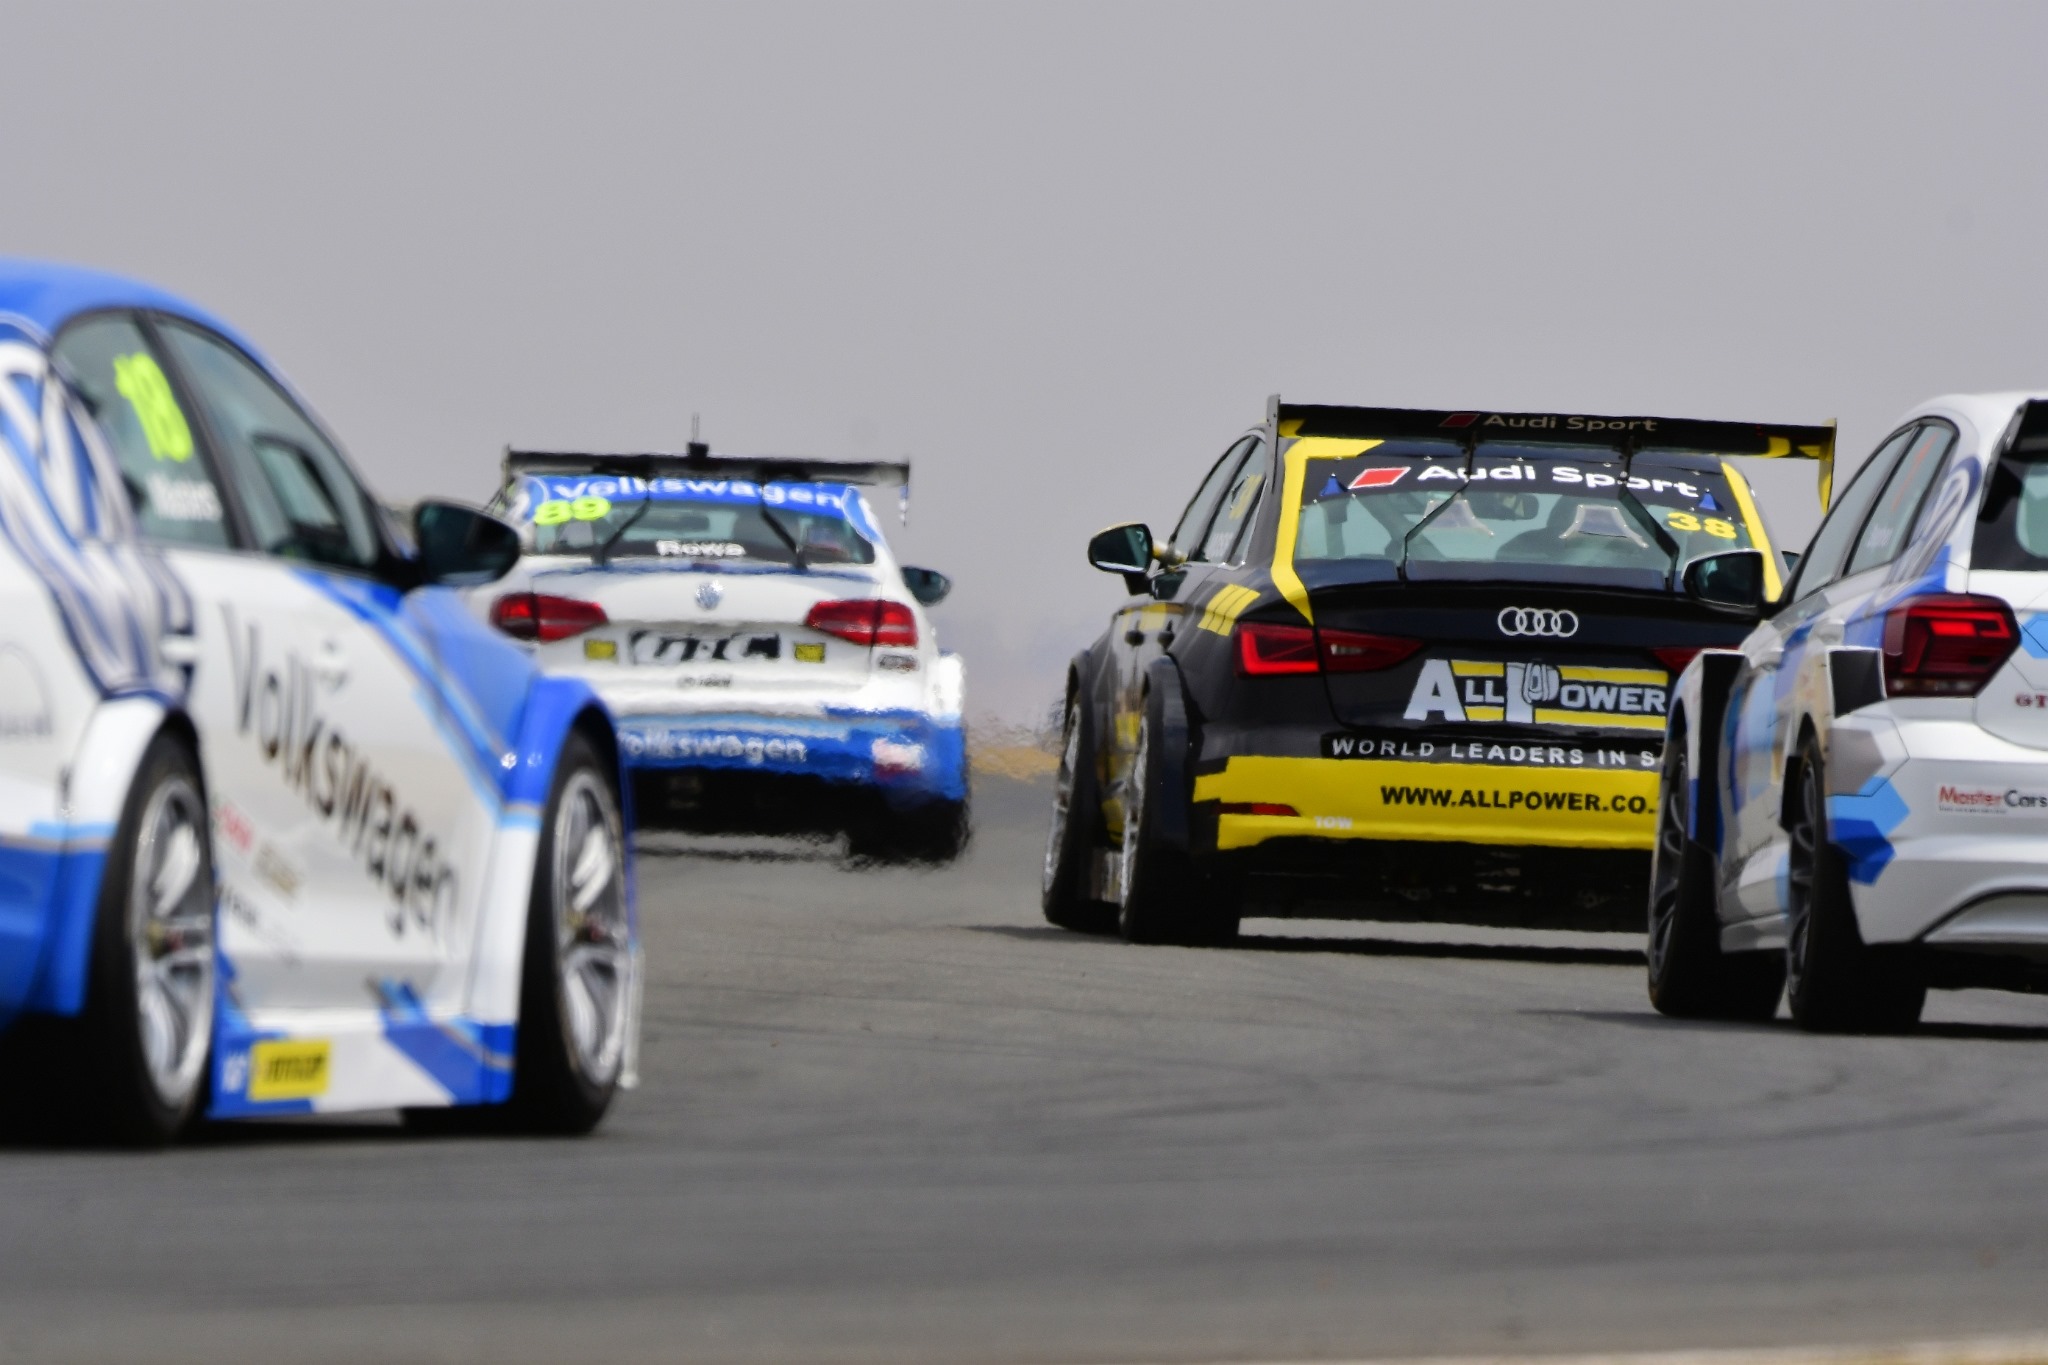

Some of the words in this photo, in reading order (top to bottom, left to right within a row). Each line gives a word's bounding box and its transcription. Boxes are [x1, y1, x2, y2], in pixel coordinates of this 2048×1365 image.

[1483, 414, 1556, 430] Audi
[1567, 416, 1659, 432] Sport
[1417, 464, 1536, 481] Audi
[1552, 465, 1700, 498] Sport
[534, 495, 611, 526] 89
[1667, 511, 1738, 540] 38
[1331, 738, 1436, 757] WORLD
[1451, 743, 1584, 765] LEADERS
[1598, 748, 1627, 767] IN
[217, 596, 460, 945] Volkswagen
